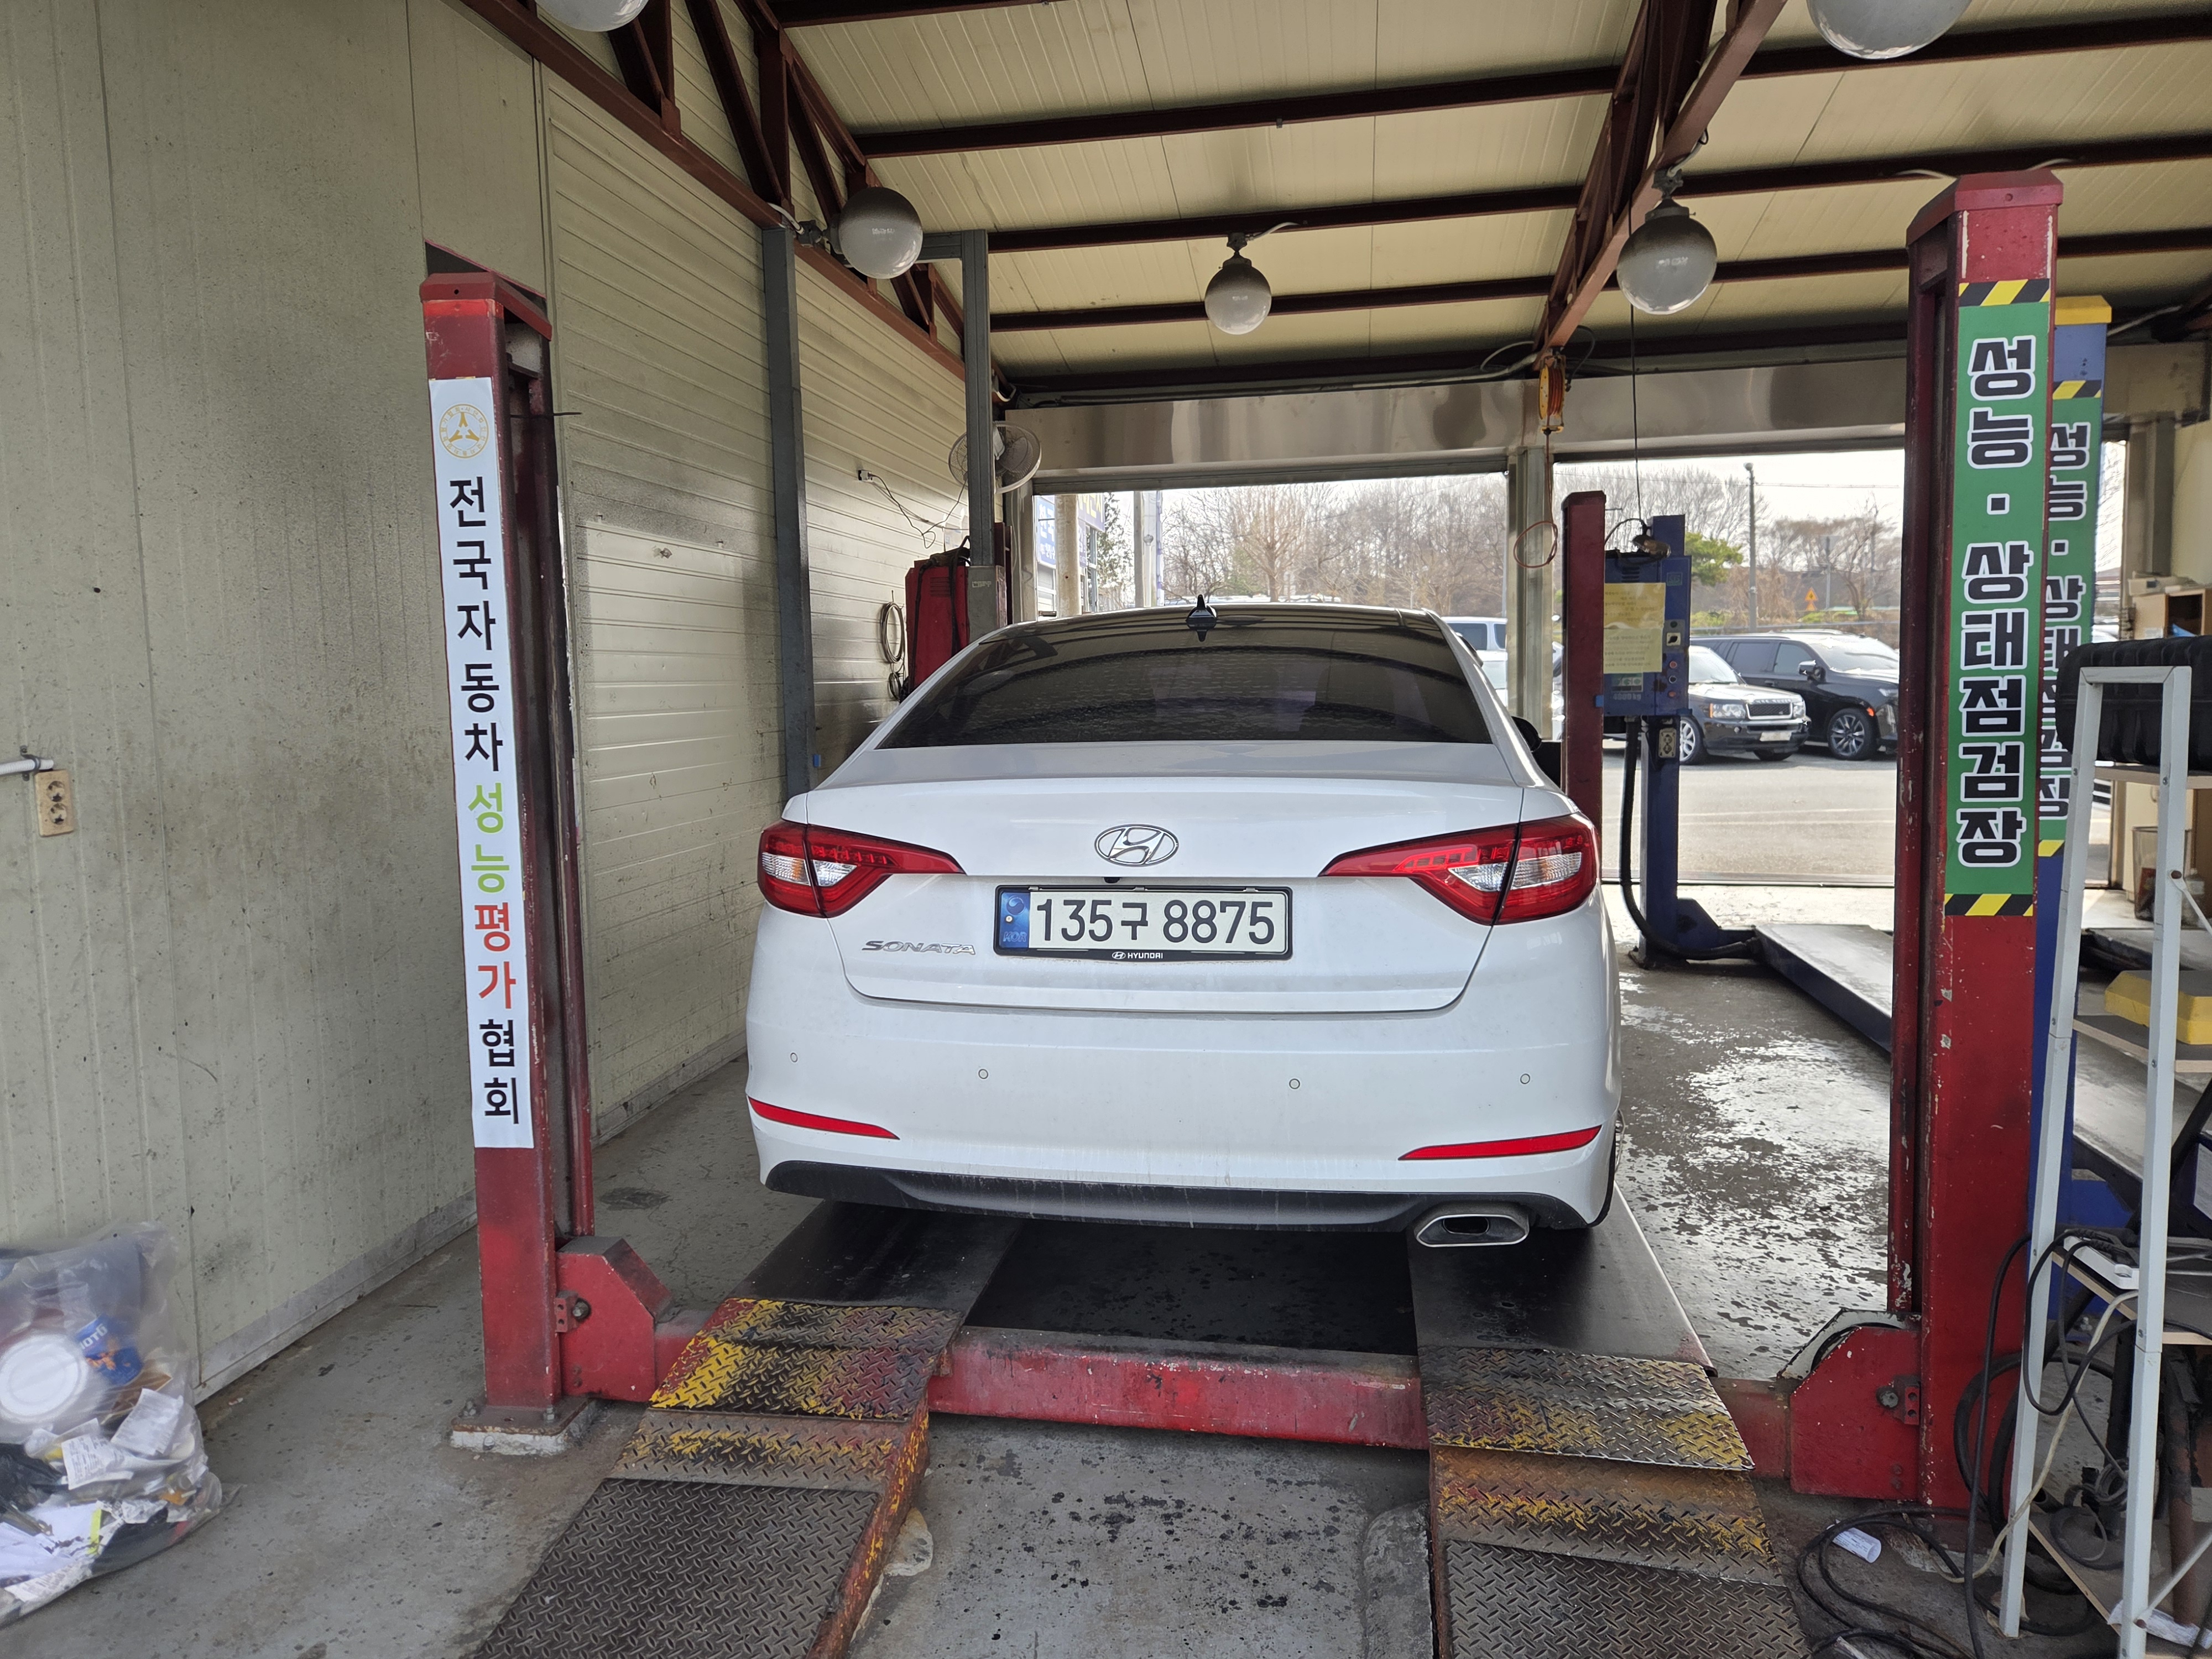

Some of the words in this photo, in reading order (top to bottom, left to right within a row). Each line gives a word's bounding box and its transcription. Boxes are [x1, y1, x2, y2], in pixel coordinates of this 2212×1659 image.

[1037, 899, 1149, 942] 135구
[1162, 899, 1275, 945] 8875
[1003, 931, 1027, 942] KOR
[862, 940, 975, 955] SONATA
